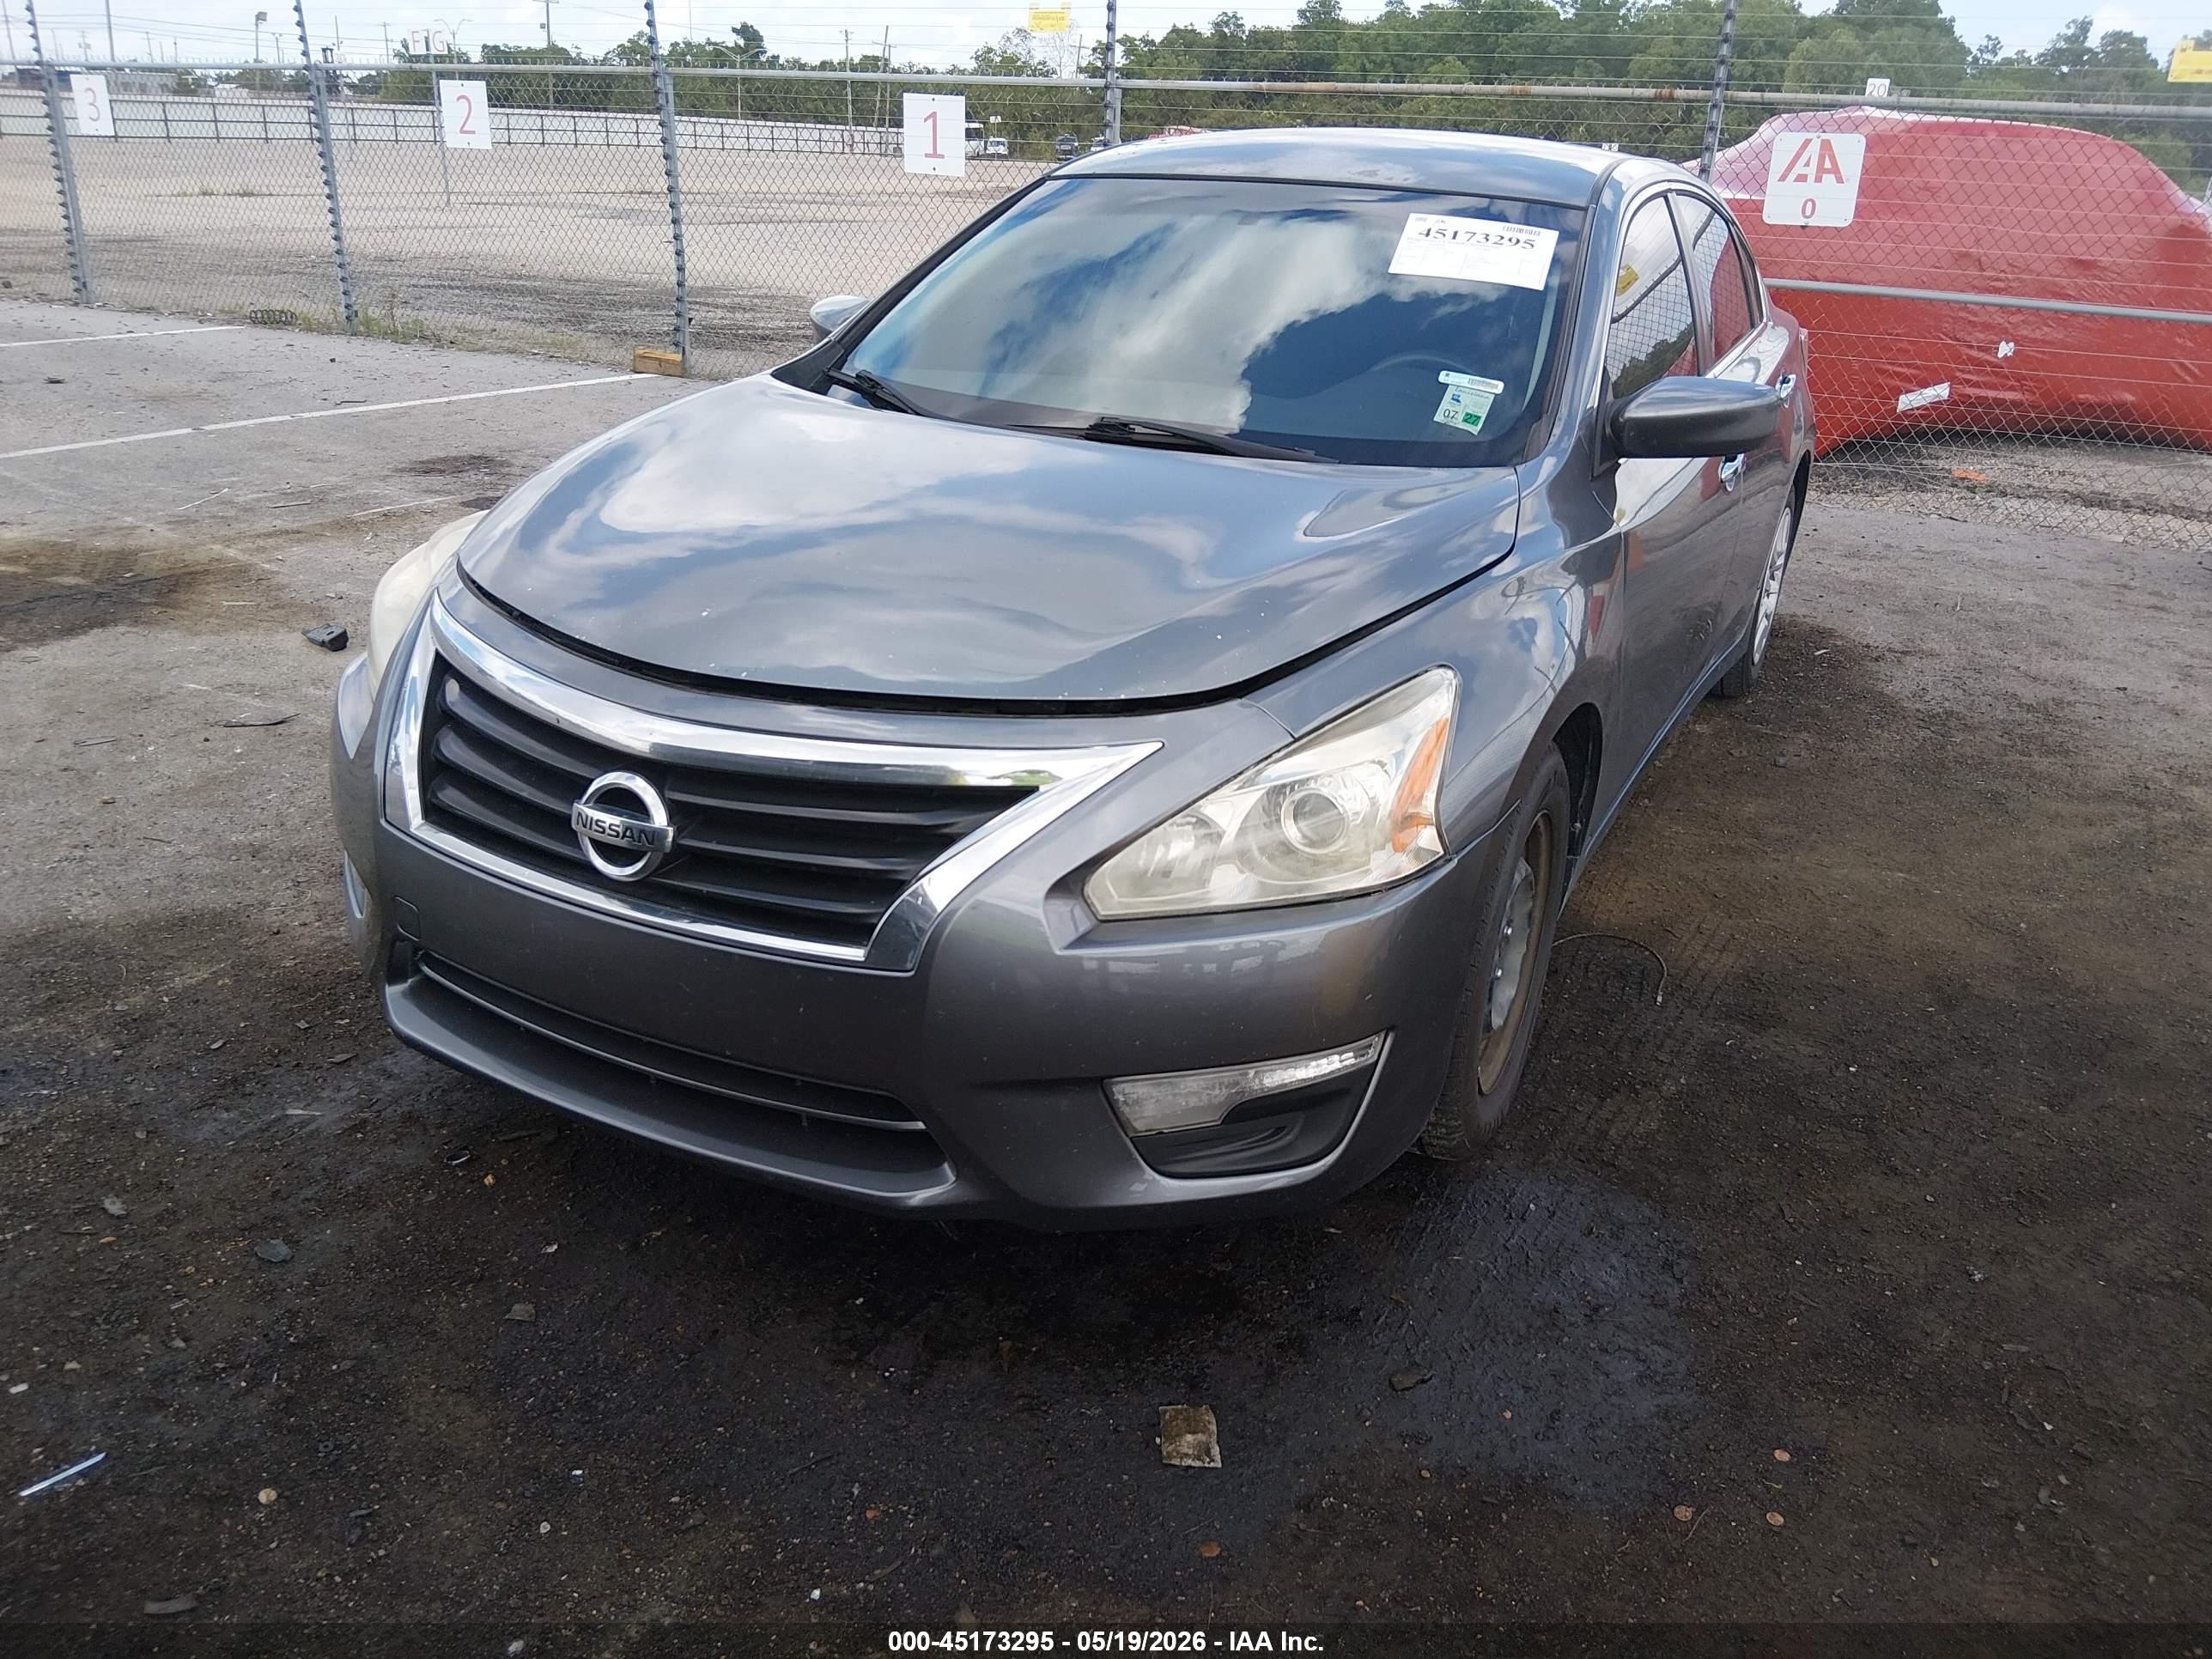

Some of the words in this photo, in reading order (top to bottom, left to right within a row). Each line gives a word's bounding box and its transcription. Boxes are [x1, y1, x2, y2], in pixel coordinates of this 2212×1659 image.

[432, 29, 445, 52] G
[84, 88, 101, 122] 3
[456, 94, 477, 135] 2
[923, 111, 945, 160] 1
[1801, 198, 1817, 220] 0
[1418, 226, 1536, 251] 45173295
[1443, 408, 1459, 421] 07
[1464, 412, 1482, 425] 27
[576, 811, 657, 846] NISSAN
